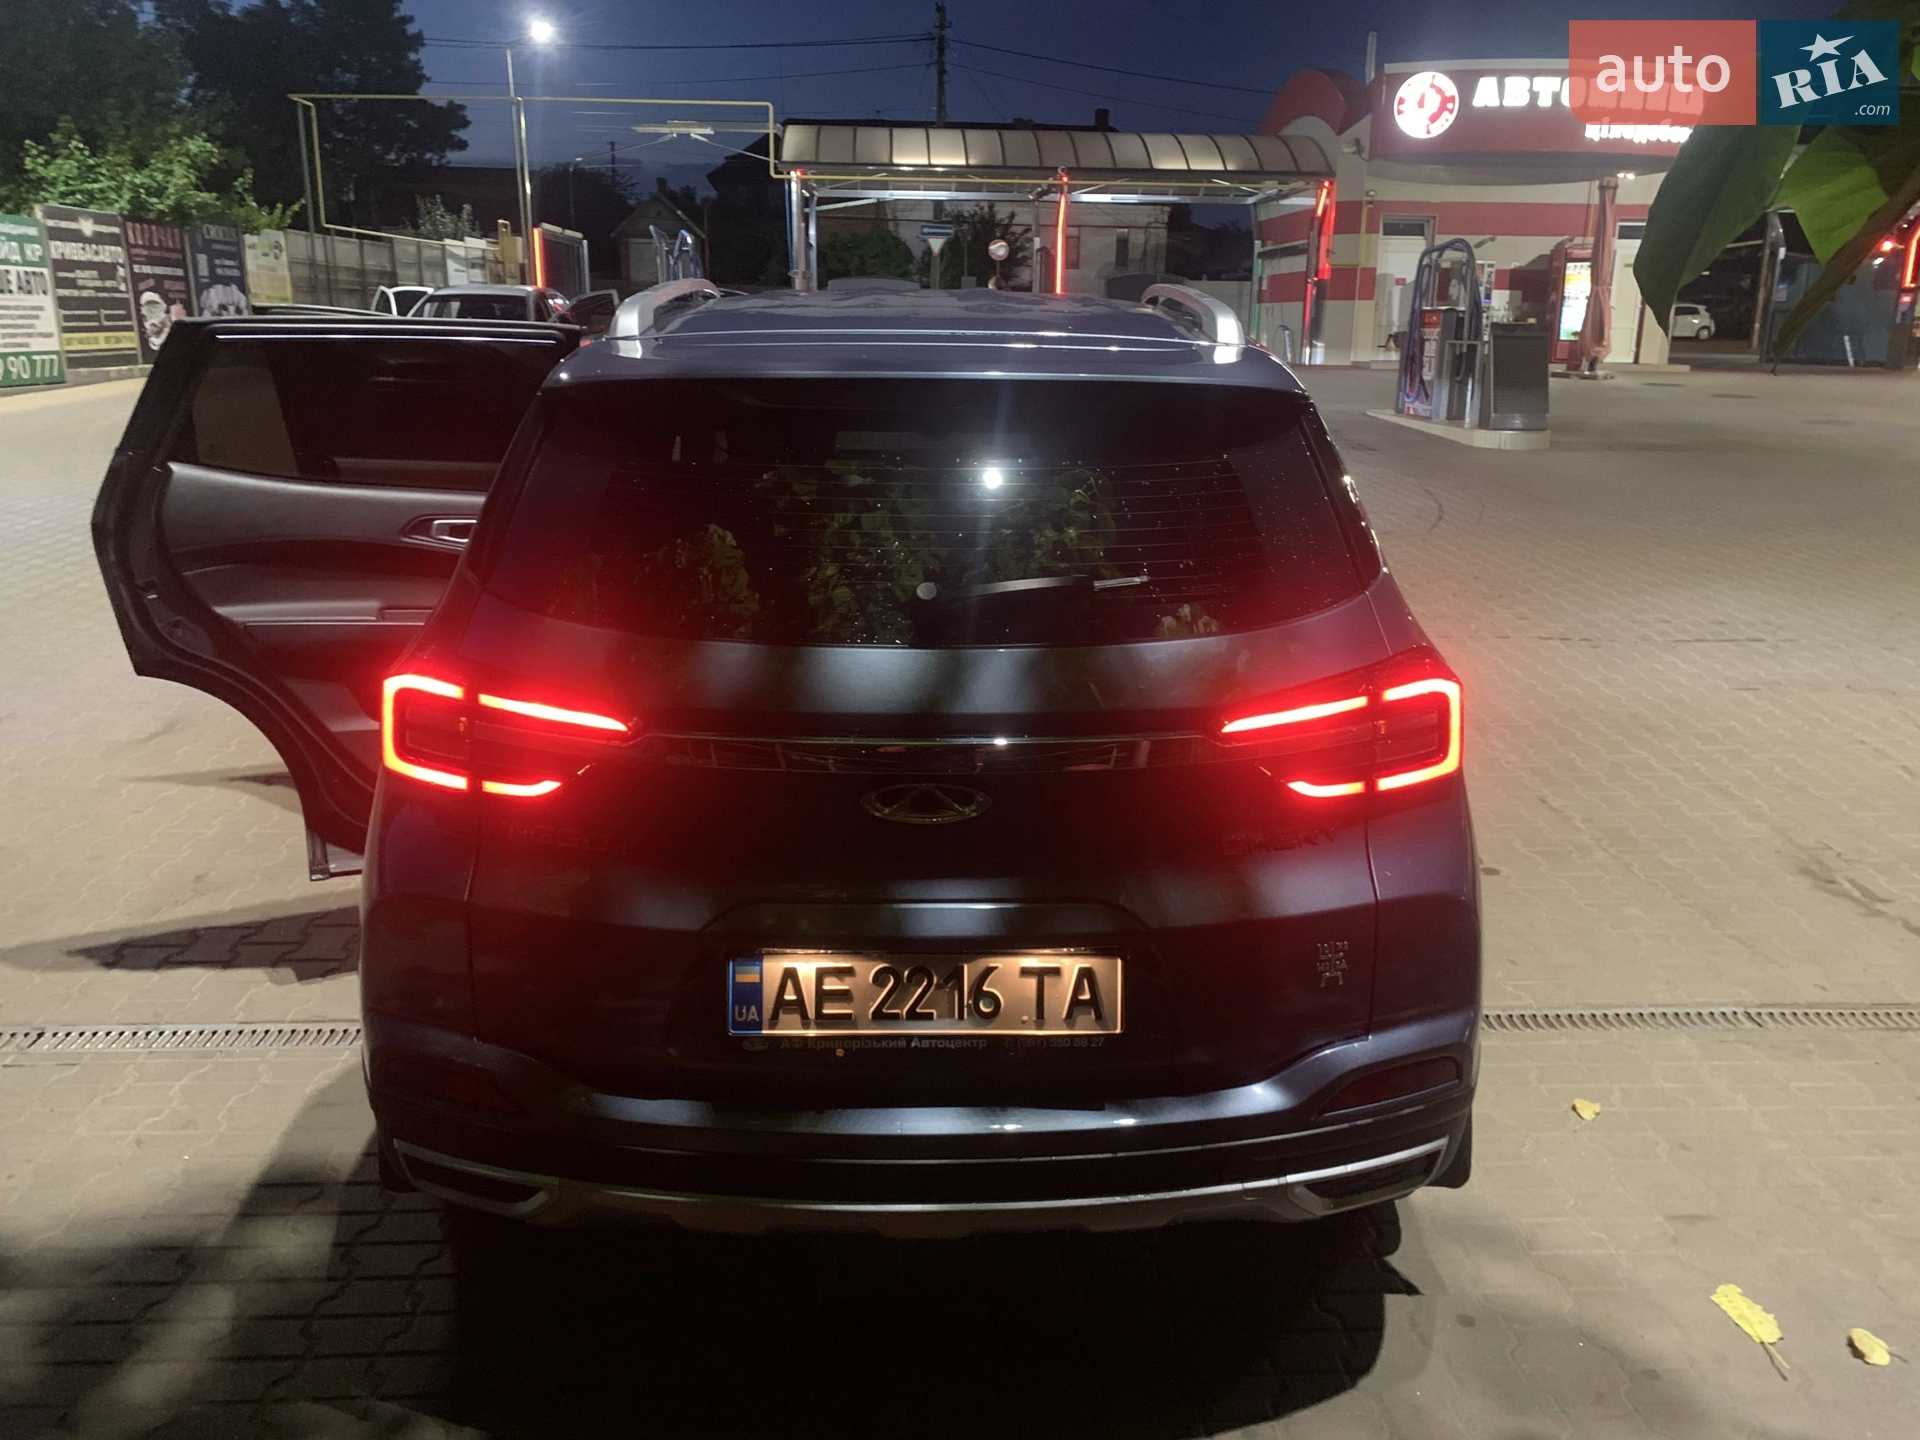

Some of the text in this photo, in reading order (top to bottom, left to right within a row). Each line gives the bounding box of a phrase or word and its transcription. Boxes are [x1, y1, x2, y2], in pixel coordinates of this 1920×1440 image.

[7, 354, 59, 379] 90 777
[769, 963, 1103, 1021] AE 2216 TA
[735, 1005, 760, 1023] UA
[808, 1036, 906, 1051] Криворізький
[911, 1036, 987, 1050] Автоцентр
[1073, 1036, 1088, 1048] 89
[1091, 1036, 1105, 1048] 27
